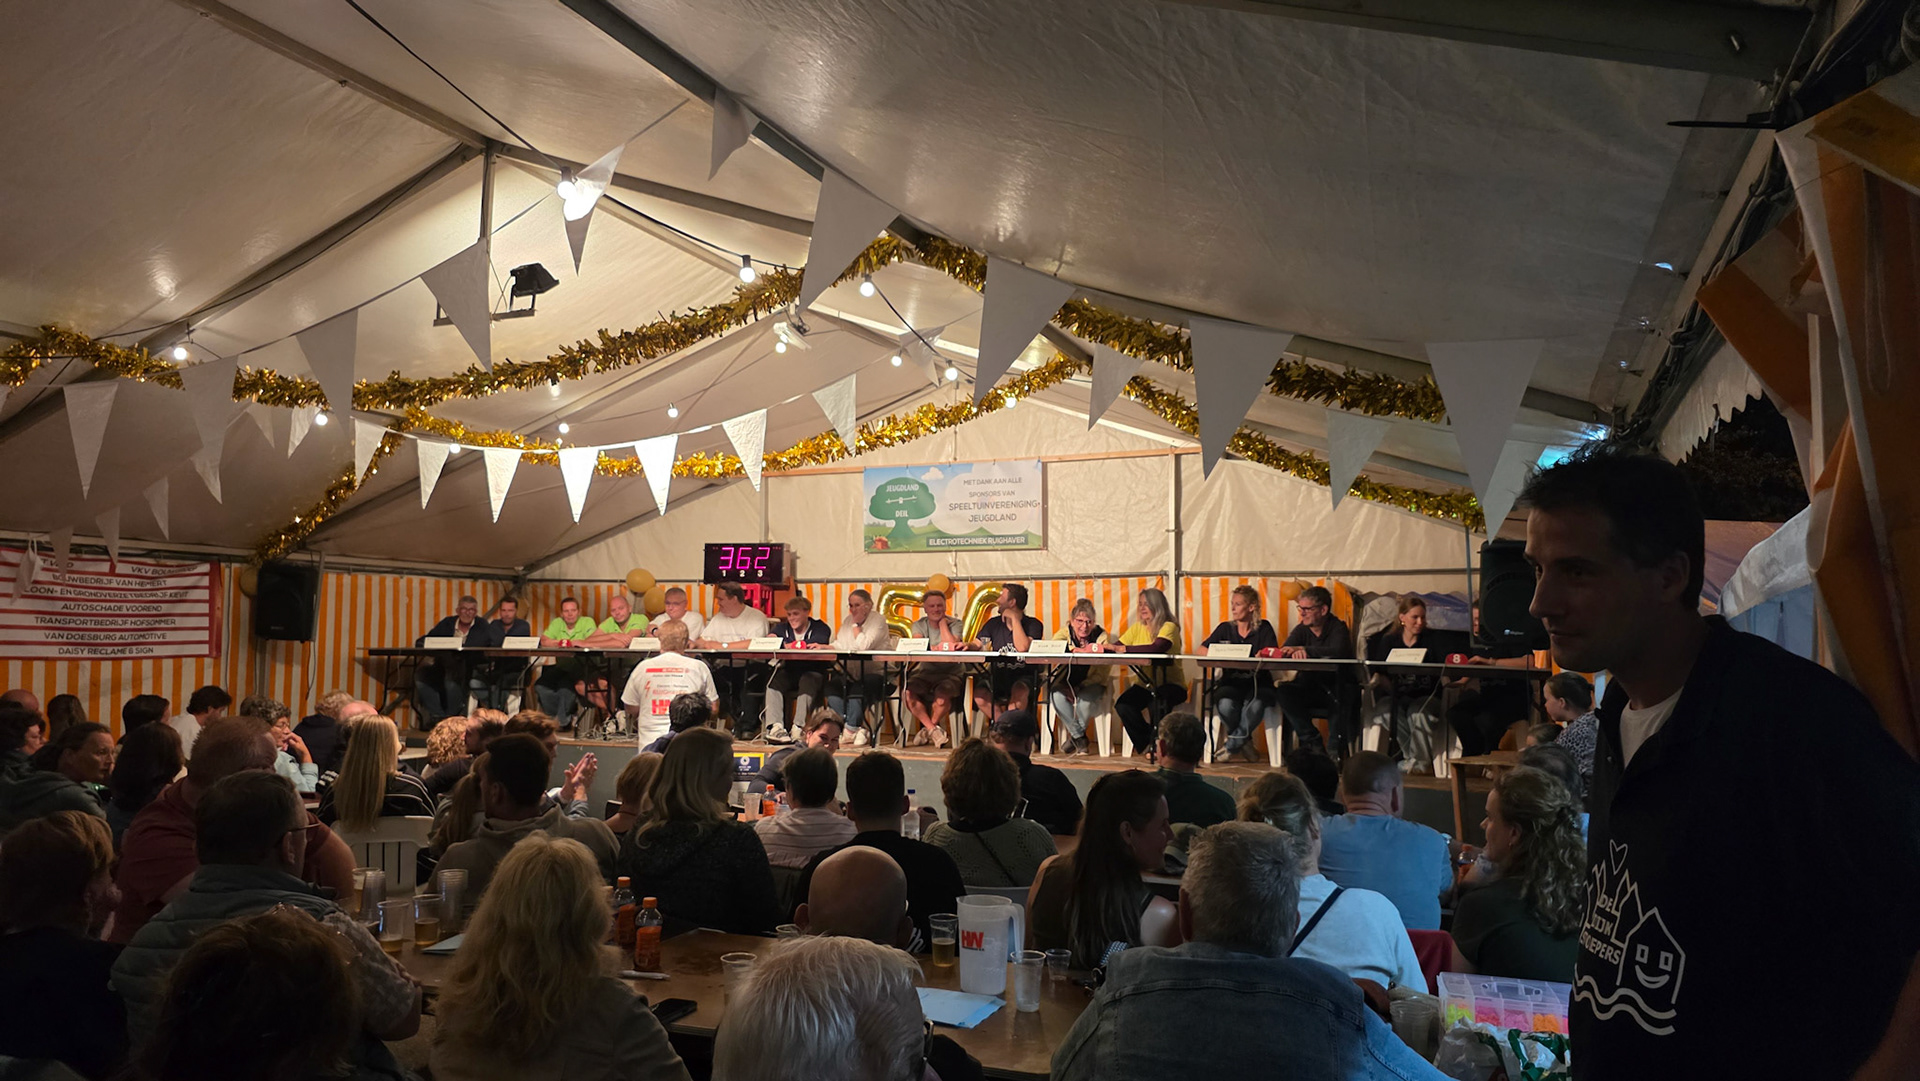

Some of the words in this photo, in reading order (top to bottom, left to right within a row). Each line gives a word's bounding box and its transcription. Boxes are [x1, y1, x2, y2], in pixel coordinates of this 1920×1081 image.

[886, 484, 919, 492] JEUGDLAND
[895, 510, 909, 518] DEIL
[968, 513, 1017, 523] JEUGDLAND
[929, 538, 987, 546] ELECTROTECHNIEK
[987, 536, 1026, 545] RUIGHAVER
[719, 547, 770, 570] 362
[131, 566, 151, 576] VKV
[740, 569, 745, 577] 2
[115, 578, 133, 587] VAN
[135, 579, 167, 587] HEMERT
[60, 587, 72, 596] EN
[73, 588, 168, 598] GRONDVERZETBEDRIJF
[61, 603, 124, 612] AUTOSCHADE
[125, 604, 162, 612] VOOREND
[35, 616, 129, 626] TRANSPORTBEDRIJF
[130, 618, 176, 626] HOFSOMMER
[44, 632, 64, 640] VAN
[65, 632, 117, 641] DOESBURG
[118, 632, 167, 641] AUTOMOTIVE
[795, 640, 802, 649] 4
[942, 642, 949, 651] 5
[1091, 643, 1098, 653] 6
[58, 646, 86, 655] DAISY
[87, 647, 127, 655] RECLAME
[1267, 647, 1275, 657] 7
[1452, 653, 1461, 664] 8
